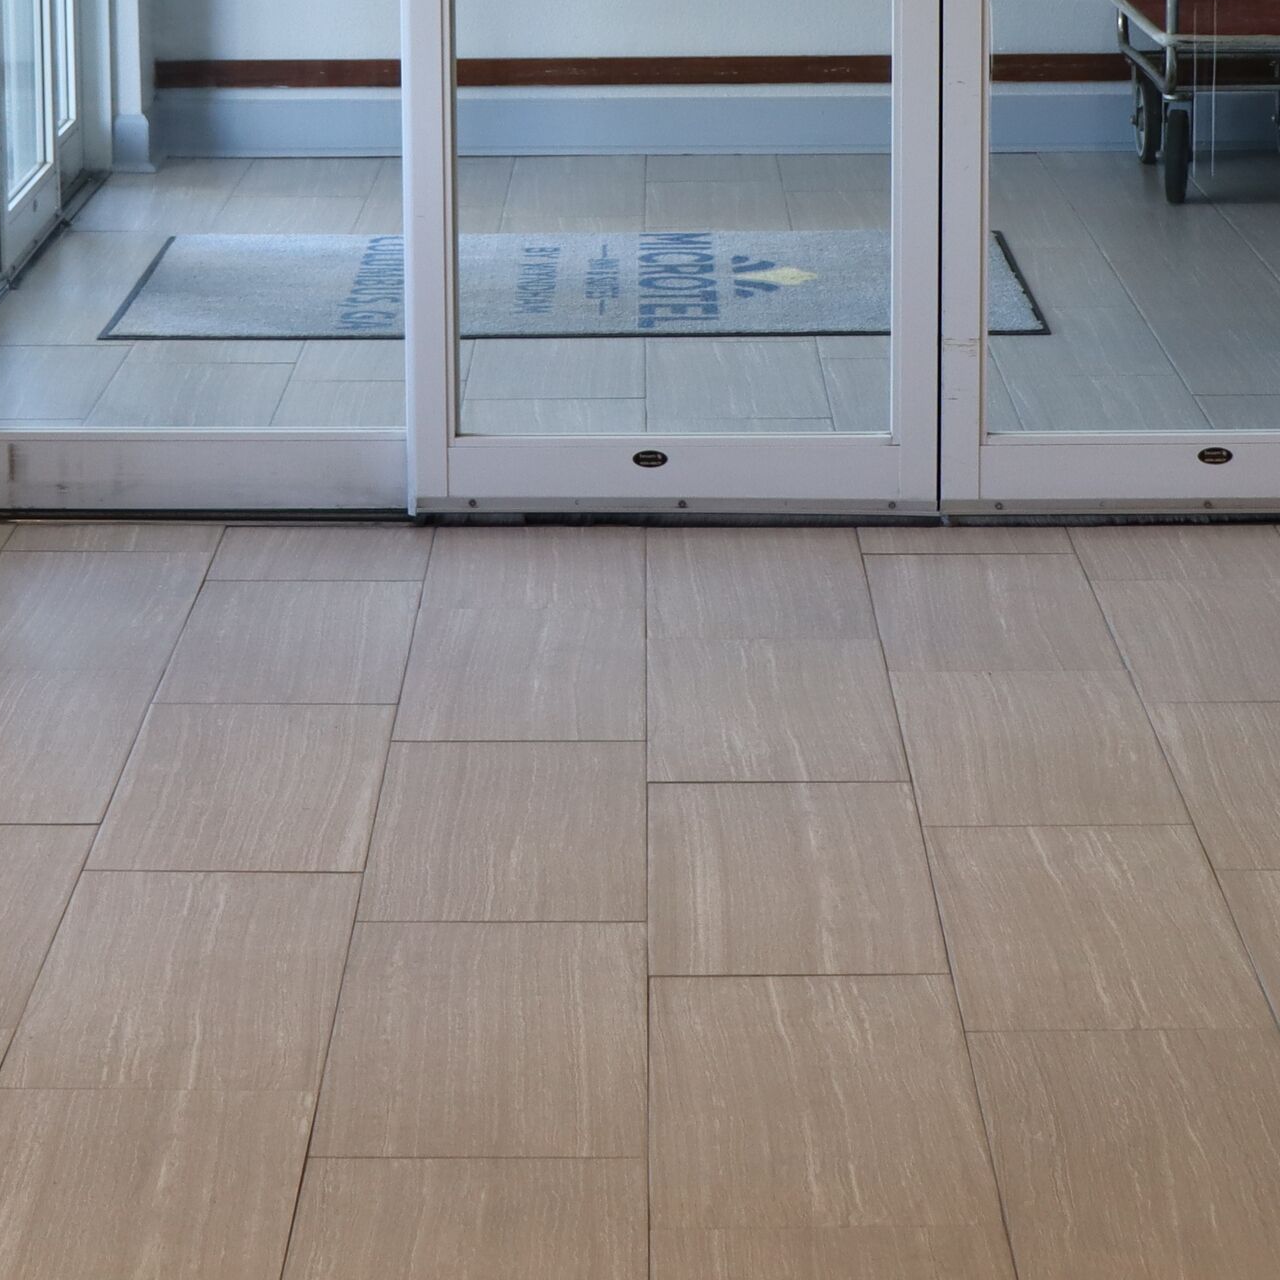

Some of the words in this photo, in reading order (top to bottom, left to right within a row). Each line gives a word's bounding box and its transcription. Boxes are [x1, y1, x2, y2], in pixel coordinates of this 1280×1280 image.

[523, 247, 560, 259] BY
[514, 262, 557, 314] WYNDHAM
[638, 232, 718, 328] MICROTEL
